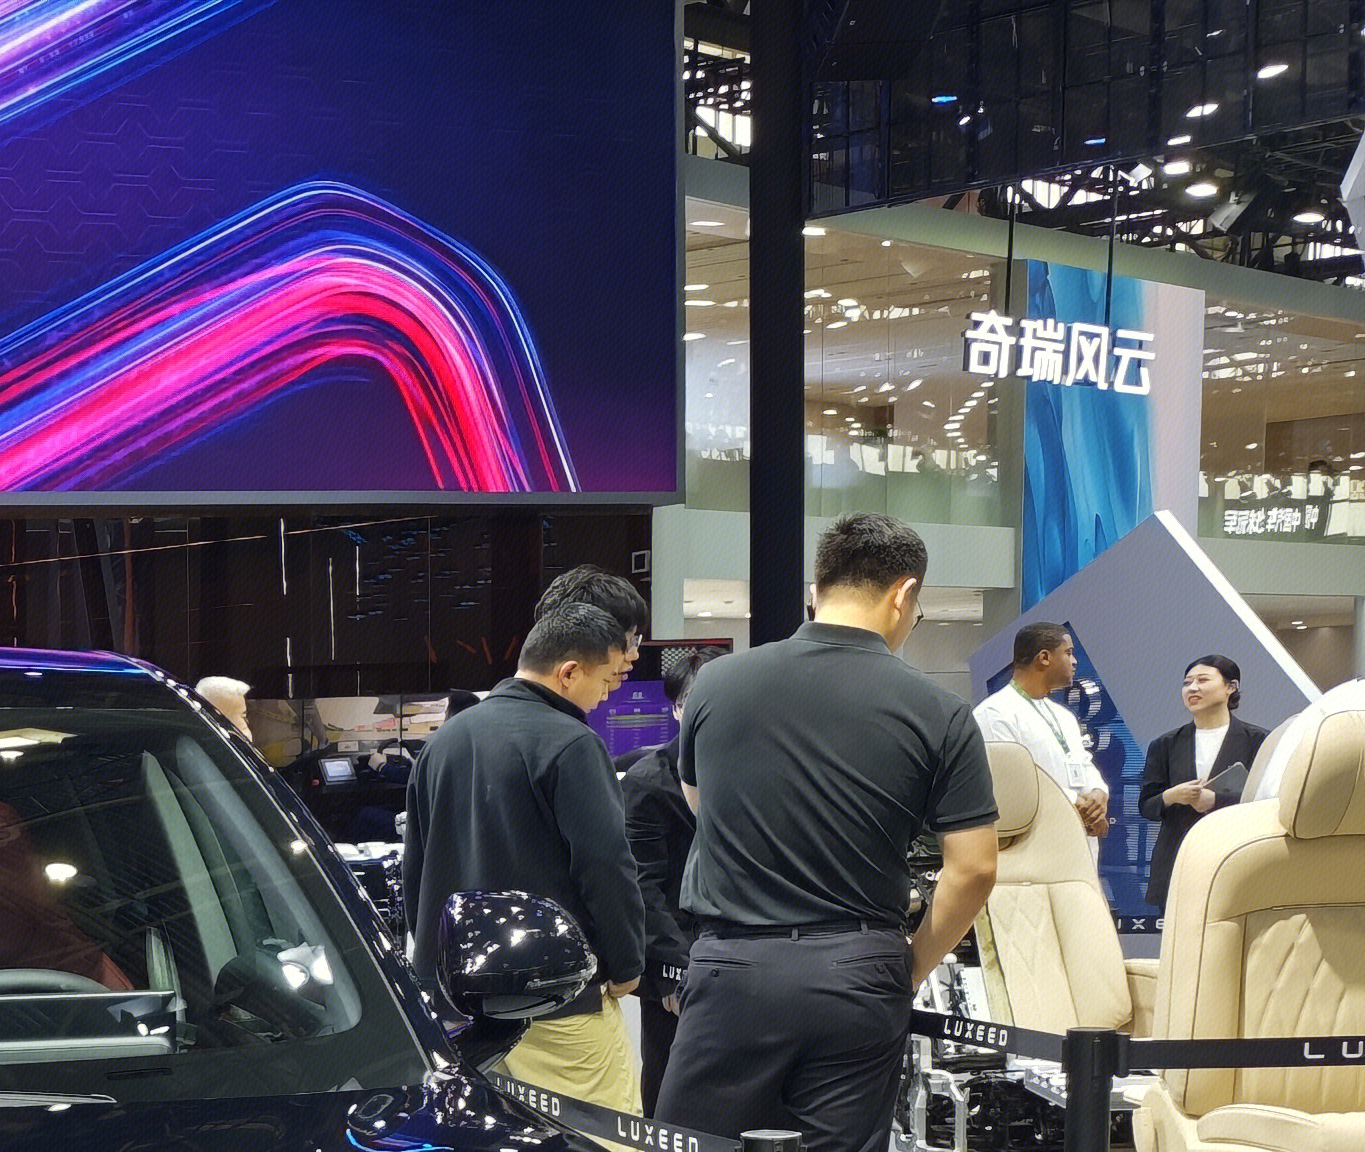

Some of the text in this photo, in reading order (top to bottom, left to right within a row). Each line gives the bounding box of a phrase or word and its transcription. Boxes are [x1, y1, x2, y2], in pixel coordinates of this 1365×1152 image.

[964, 309, 1156, 395] 奇瑞风云
[662, 964, 682, 981] LUX
[943, 1018, 1008, 1047] LUXEED
